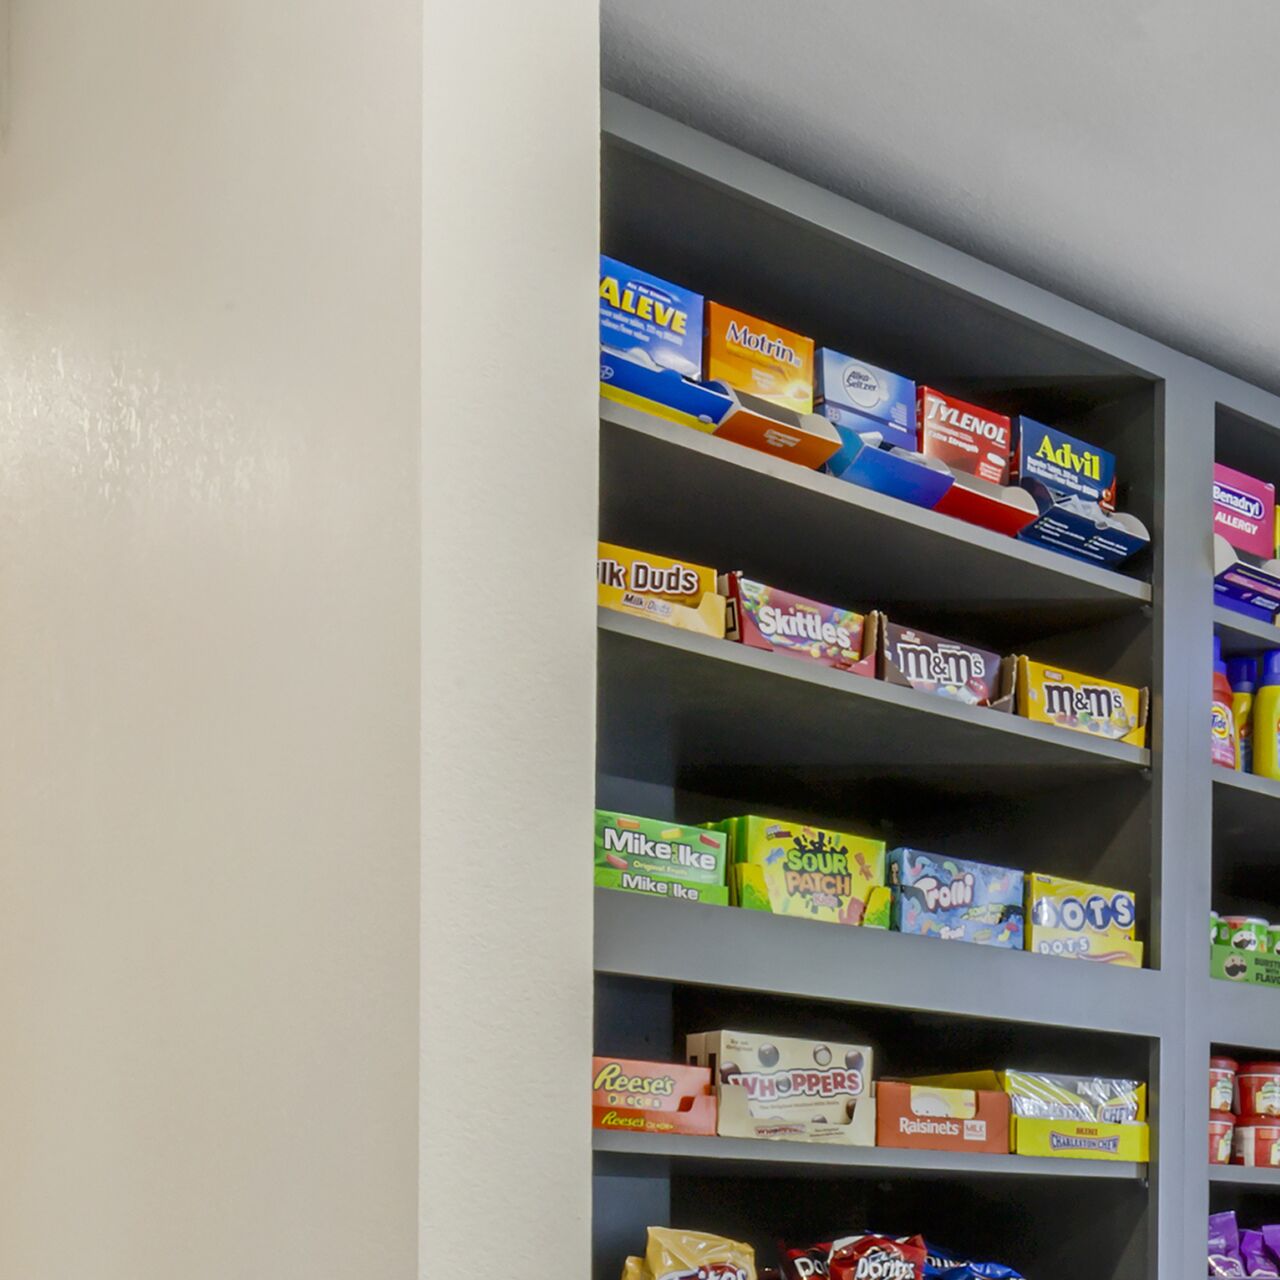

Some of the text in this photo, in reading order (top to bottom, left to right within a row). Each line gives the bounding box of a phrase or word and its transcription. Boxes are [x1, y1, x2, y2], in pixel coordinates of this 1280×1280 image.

[600, 276, 688, 336] ALEVE
[725, 320, 796, 364] Motrin
[847, 378, 877, 392] Seltzer
[927, 396, 1008, 445] TYLENOL
[1036, 435, 1101, 480] Advil
[1213, 486, 1260, 516] Benadryl
[1215, 511, 1258, 535] ALLERGY
[632, 561, 699, 594] Duds
[623, 593, 645, 608] Milk
[759, 604, 851, 649] Skittles
[604, 828, 717, 871] Mike Ike
[786, 850, 848, 874] SOUR
[622, 873, 699, 900] Mike Ike
[785, 871, 852, 897] PATCH
[913, 872, 976, 912] Trolli
[1032, 893, 1136, 932] DOTS
[1040, 937, 1090, 955] DOTS
[594, 1063, 676, 1096] Reese's
[728, 1068, 863, 1098] WHOPPERS
[601, 1111, 646, 1128] Reese's
[899, 1117, 961, 1136] Raisinets
[857, 1257, 916, 1279] Doritos
